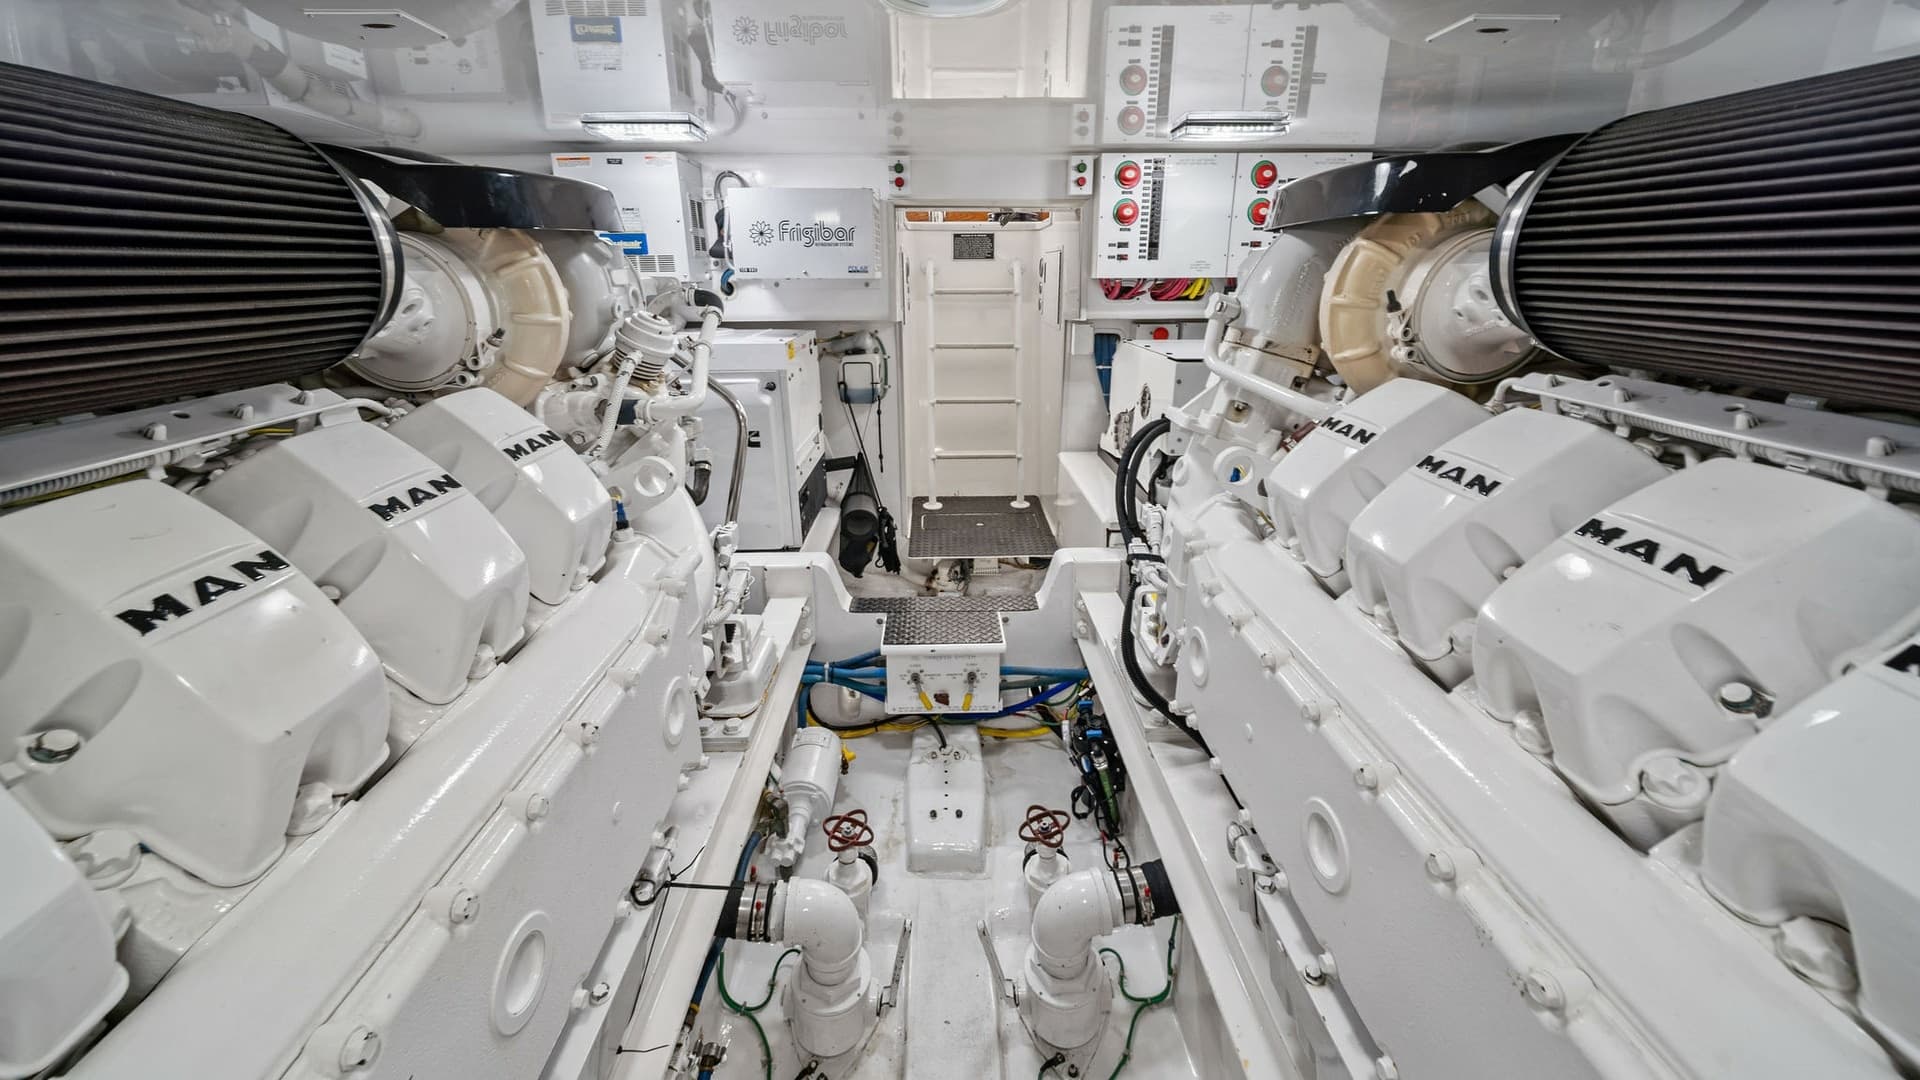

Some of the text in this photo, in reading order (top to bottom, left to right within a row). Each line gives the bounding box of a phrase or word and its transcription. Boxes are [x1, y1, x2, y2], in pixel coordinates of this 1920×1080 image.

[778, 220, 855, 247] Frigibar
[502, 430, 562, 462] MAN
[1320, 417, 1376, 445] MAN
[1416, 455, 1502, 497] MAN
[368, 474, 462, 521] MAN
[1574, 518, 1731, 590] MAN
[115, 550, 290, 636] MAN
